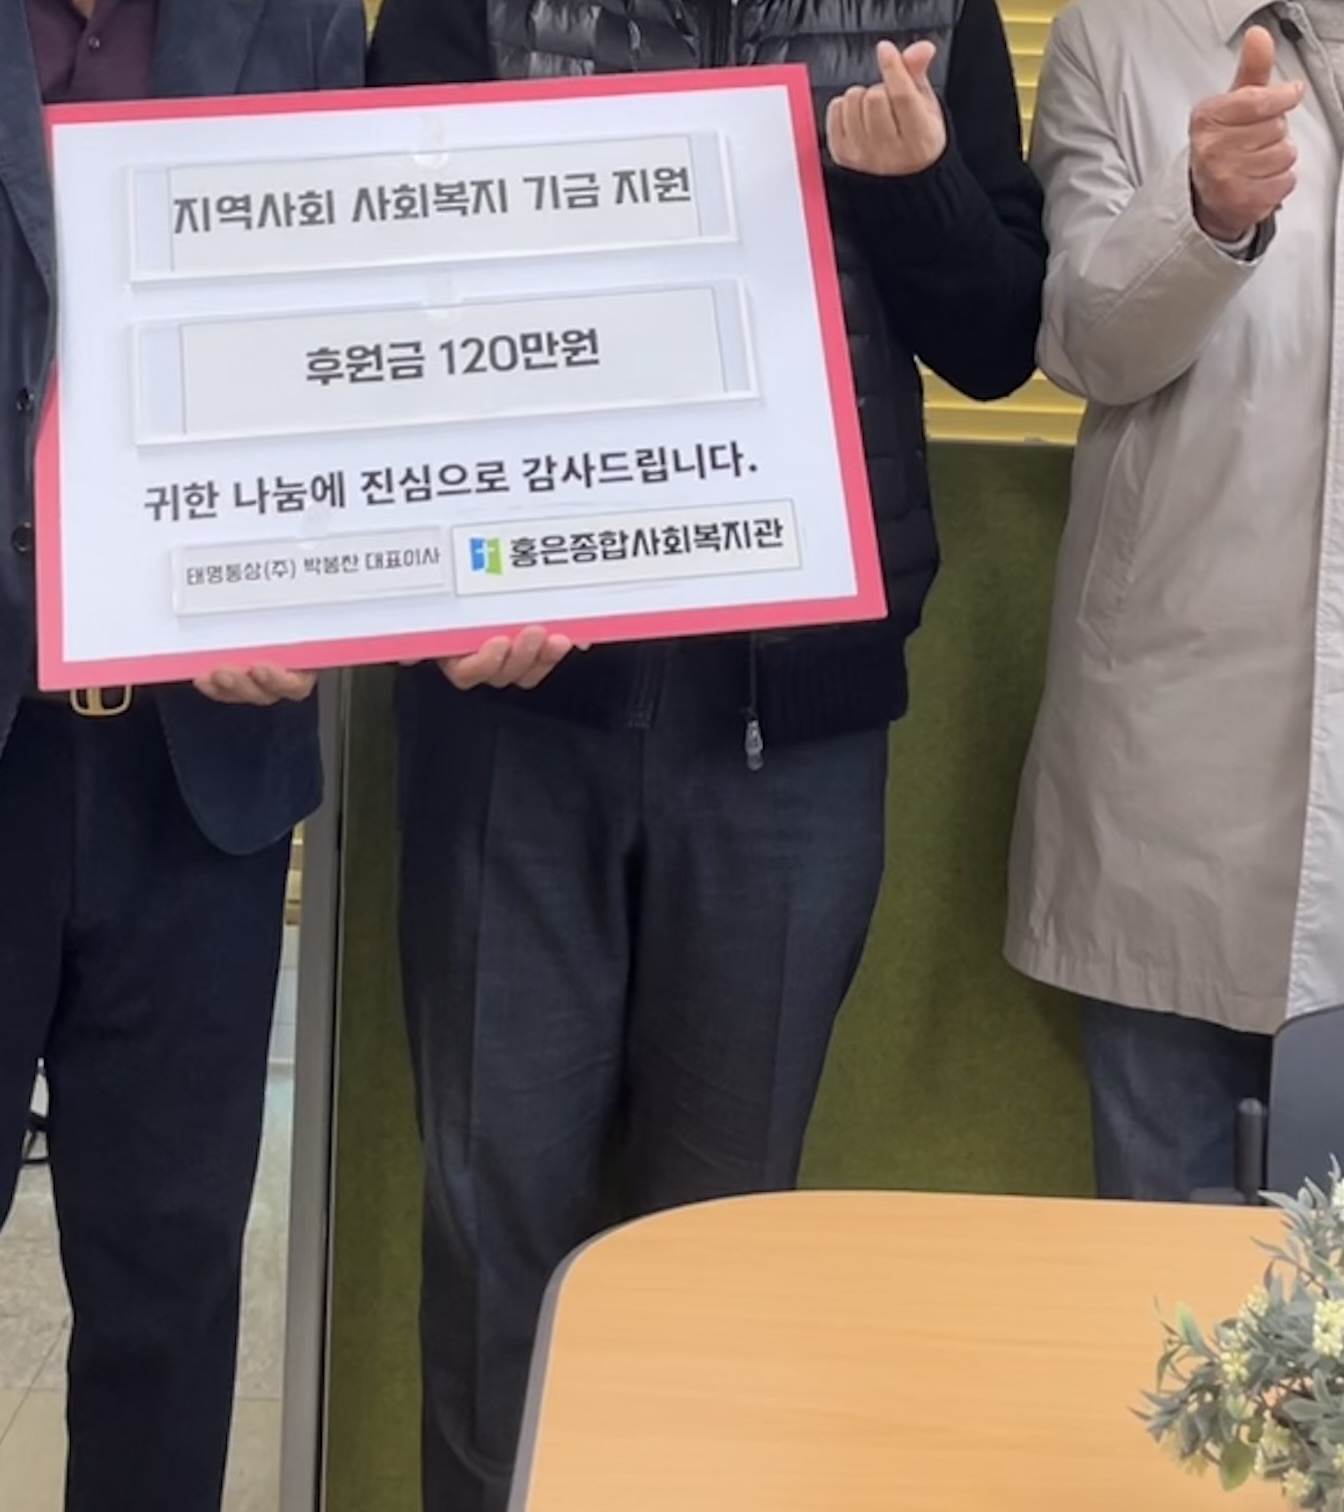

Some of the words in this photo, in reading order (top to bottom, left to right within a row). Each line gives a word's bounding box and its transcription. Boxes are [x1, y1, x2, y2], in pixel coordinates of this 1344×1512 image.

[173, 188, 336, 234] 지역사회
[351, 178, 509, 223] 사회복지
[522, 172, 601, 211] 기금
[611, 166, 692, 205] 지원
[305, 340, 426, 386] 후원금
[438, 327, 600, 375] 120만원
[143, 480, 220, 522] 귀한
[233, 470, 347, 515] 나눔에
[360, 460, 510, 506] 진심으로
[522, 440, 759, 494] 감사드립니다.
[365, 546, 442, 571] 대표이사
[509, 518, 784, 569] 홍은종합사회복지관
